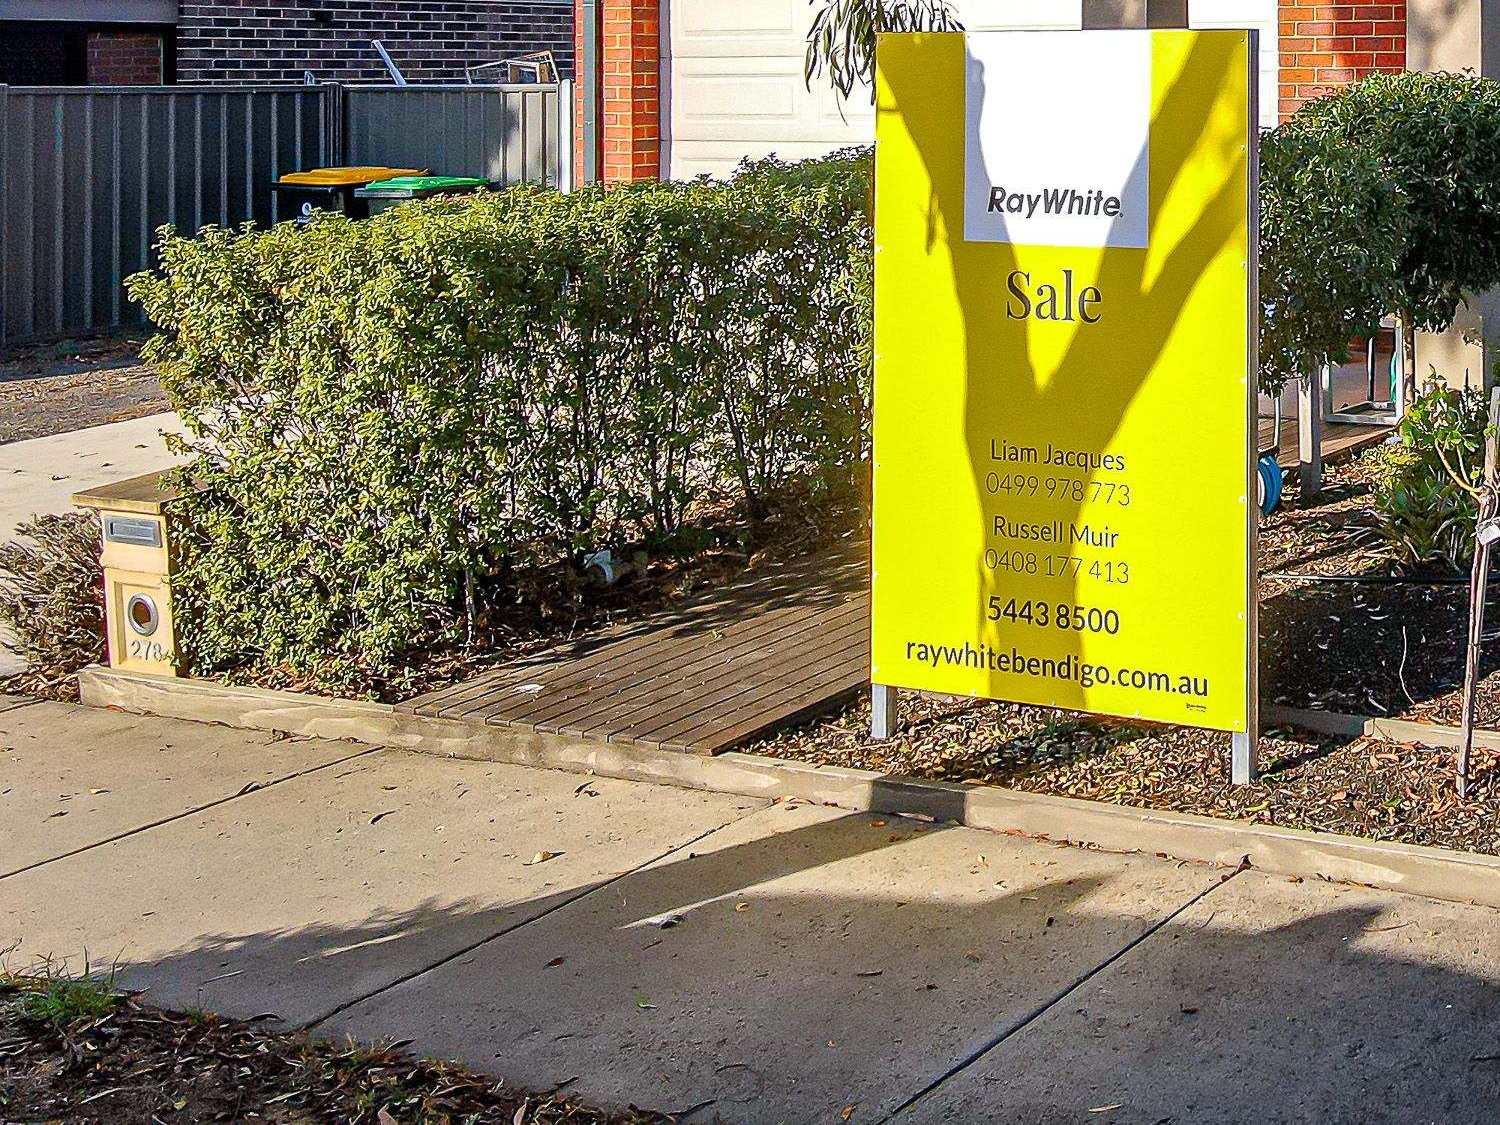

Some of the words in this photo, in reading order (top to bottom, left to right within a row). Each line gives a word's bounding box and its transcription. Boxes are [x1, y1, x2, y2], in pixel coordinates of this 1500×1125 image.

[1006, 269, 1102, 324] Sale
[990, 438, 1037, 463] Liam
[1043, 444, 1125, 473] Jacques
[986, 472, 1039, 497] 0499
[1045, 477, 1084, 501] 978
[1090, 481, 1130, 506] 773
[993, 515, 1063, 543] Russell
[1070, 523, 1119, 548] Muir
[985, 548, 1037, 574] 0408
[1044, 554, 1083, 579] 177
[1088, 560, 1129, 584] 413
[987, 596, 1049, 627] 5443
[1056, 606, 1120, 635] 8500
[905, 639, 1209, 697] raywhitebendigo.com.au
